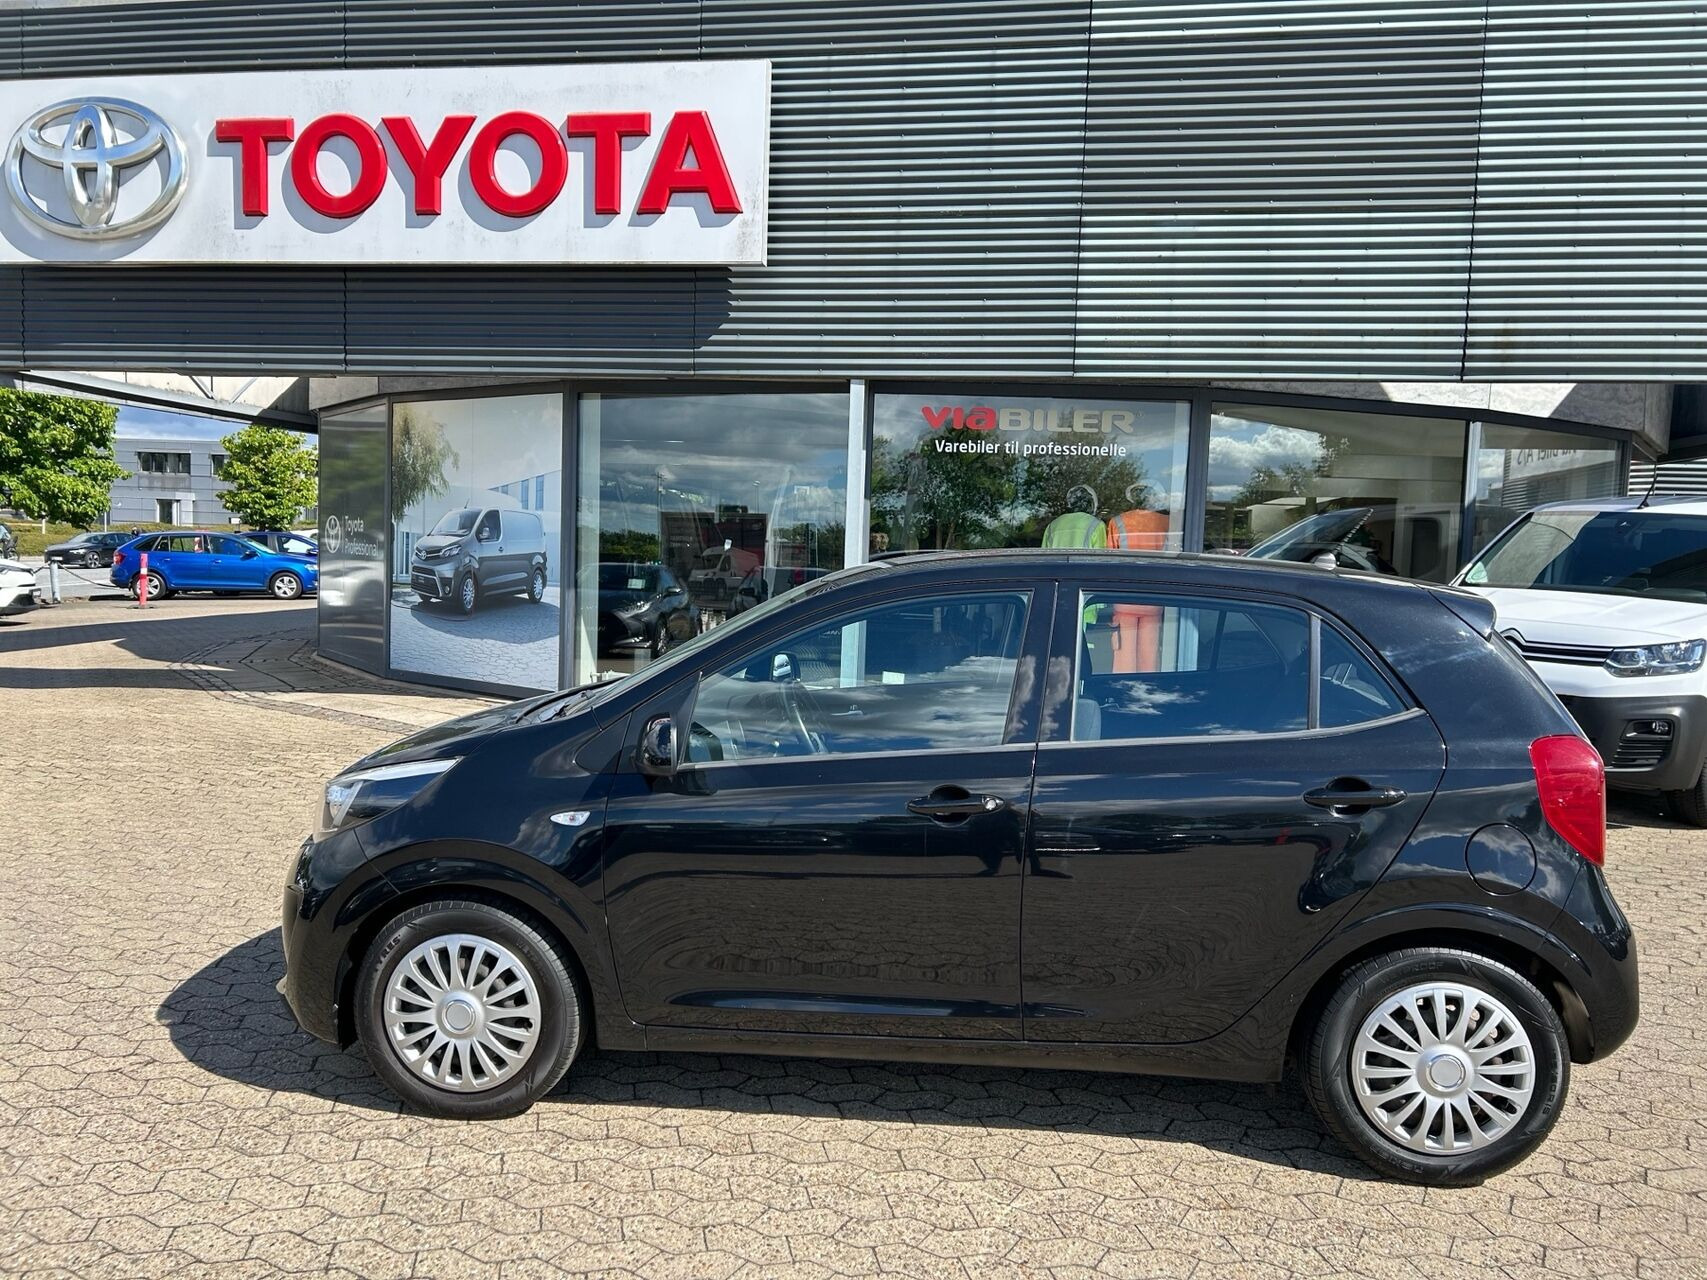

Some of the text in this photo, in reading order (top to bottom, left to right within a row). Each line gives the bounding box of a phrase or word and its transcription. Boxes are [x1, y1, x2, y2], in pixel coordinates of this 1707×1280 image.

[216, 110, 743, 217] TOYOTA
[935, 440, 1127, 457] Varebiler til professionelle
[345, 516, 364, 535] Toyota
[344, 538, 379, 557] Professional
